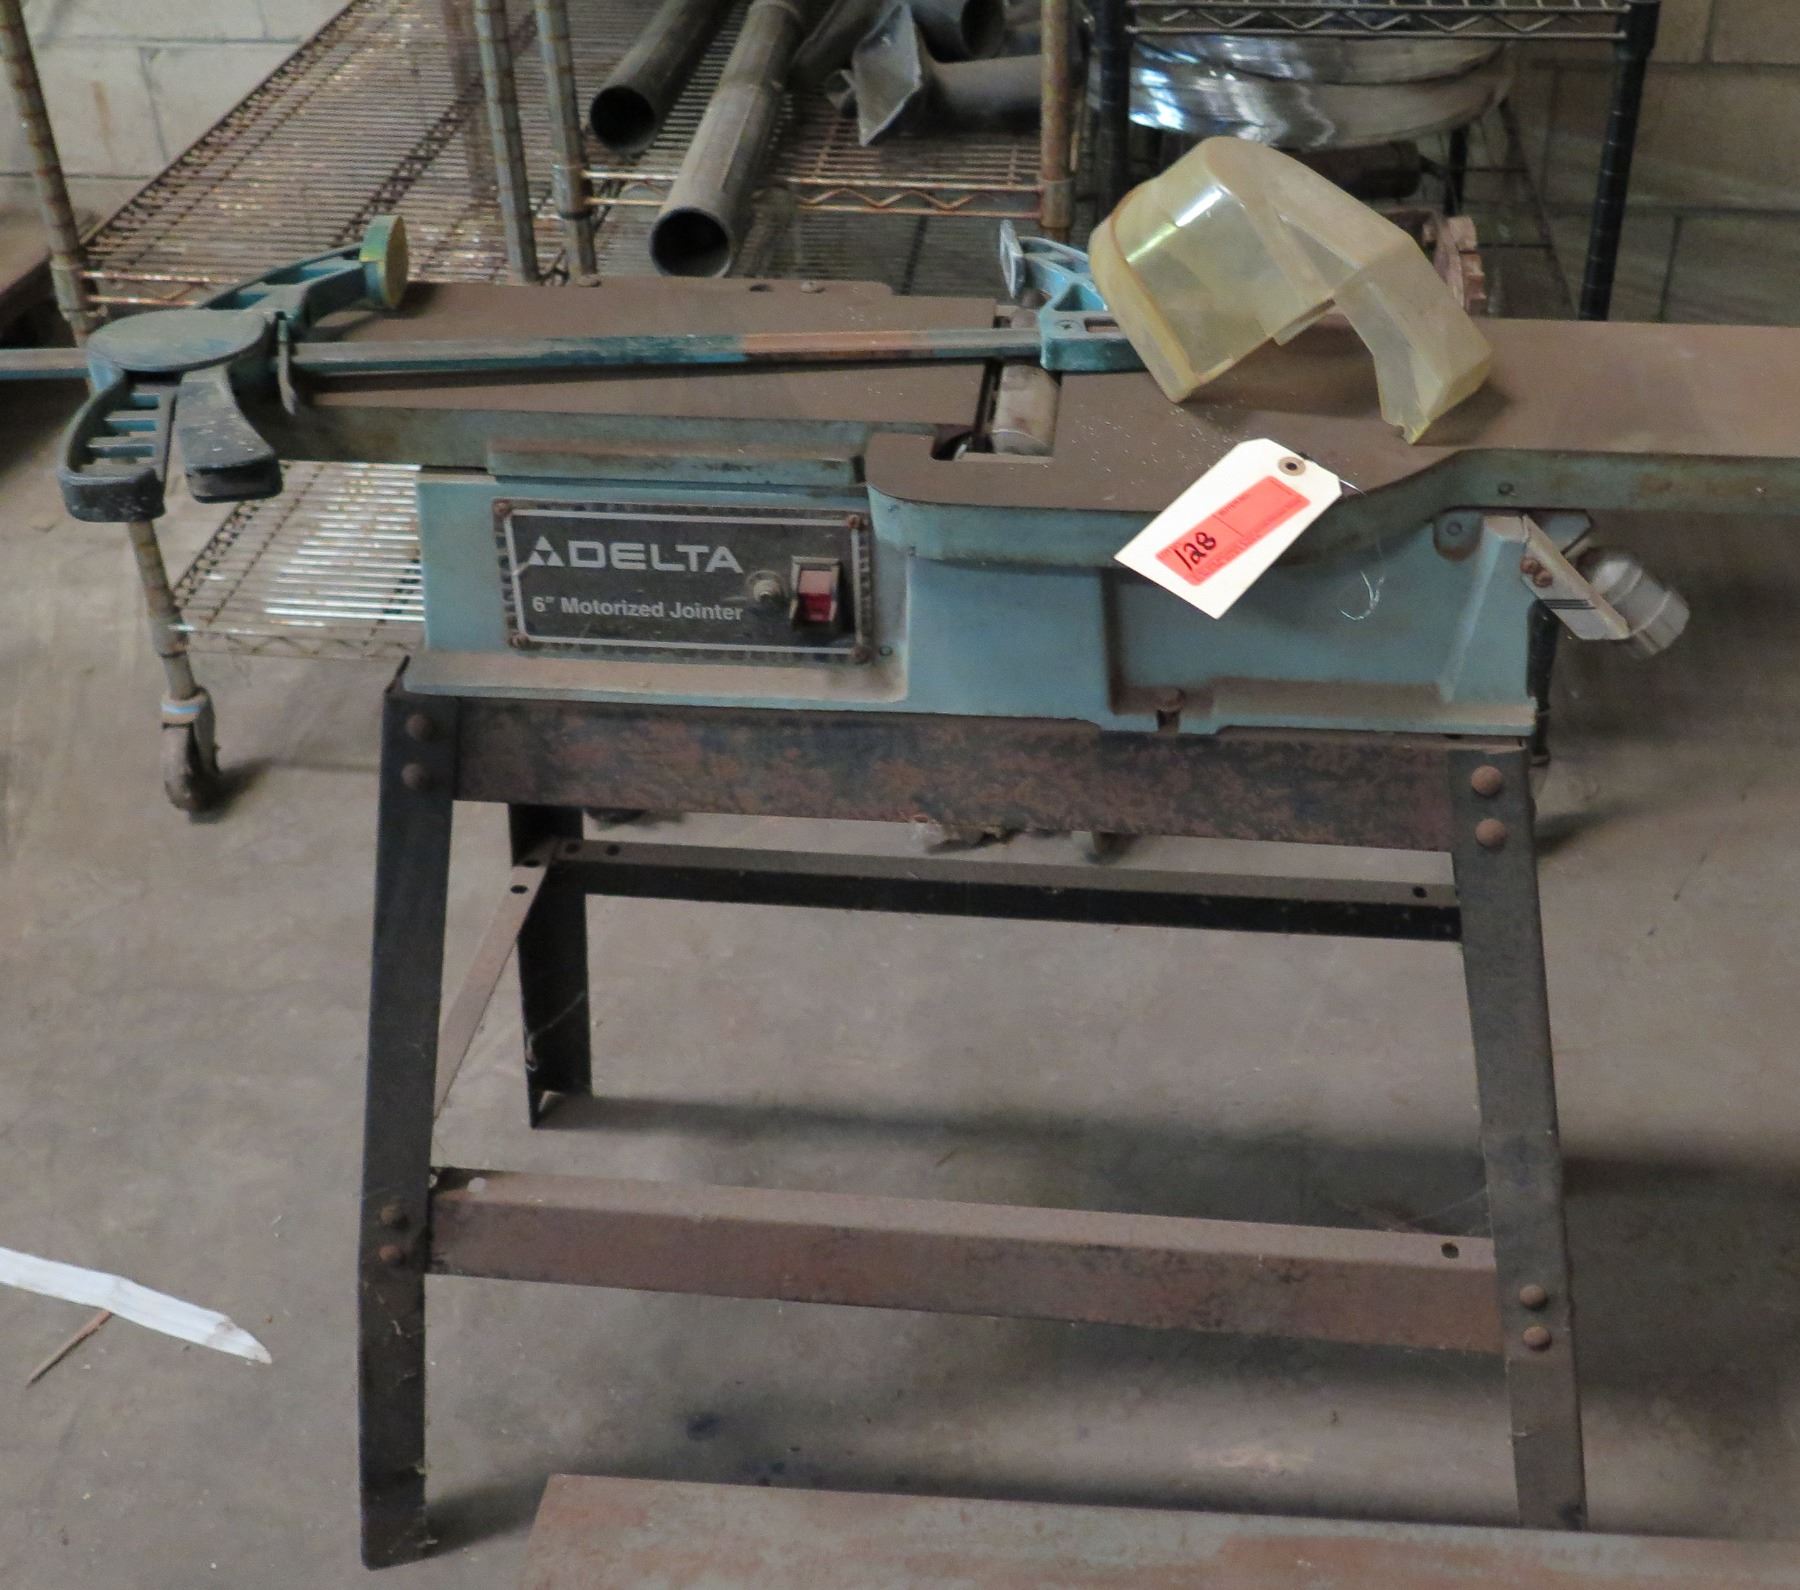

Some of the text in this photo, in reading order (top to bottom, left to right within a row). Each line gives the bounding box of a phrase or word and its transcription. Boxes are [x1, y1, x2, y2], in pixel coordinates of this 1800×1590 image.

[569, 540, 744, 573] DELTA
[1175, 532, 1217, 571] 128
[561, 597, 665, 618] Motorized
[670, 601, 743, 620] Jointer
